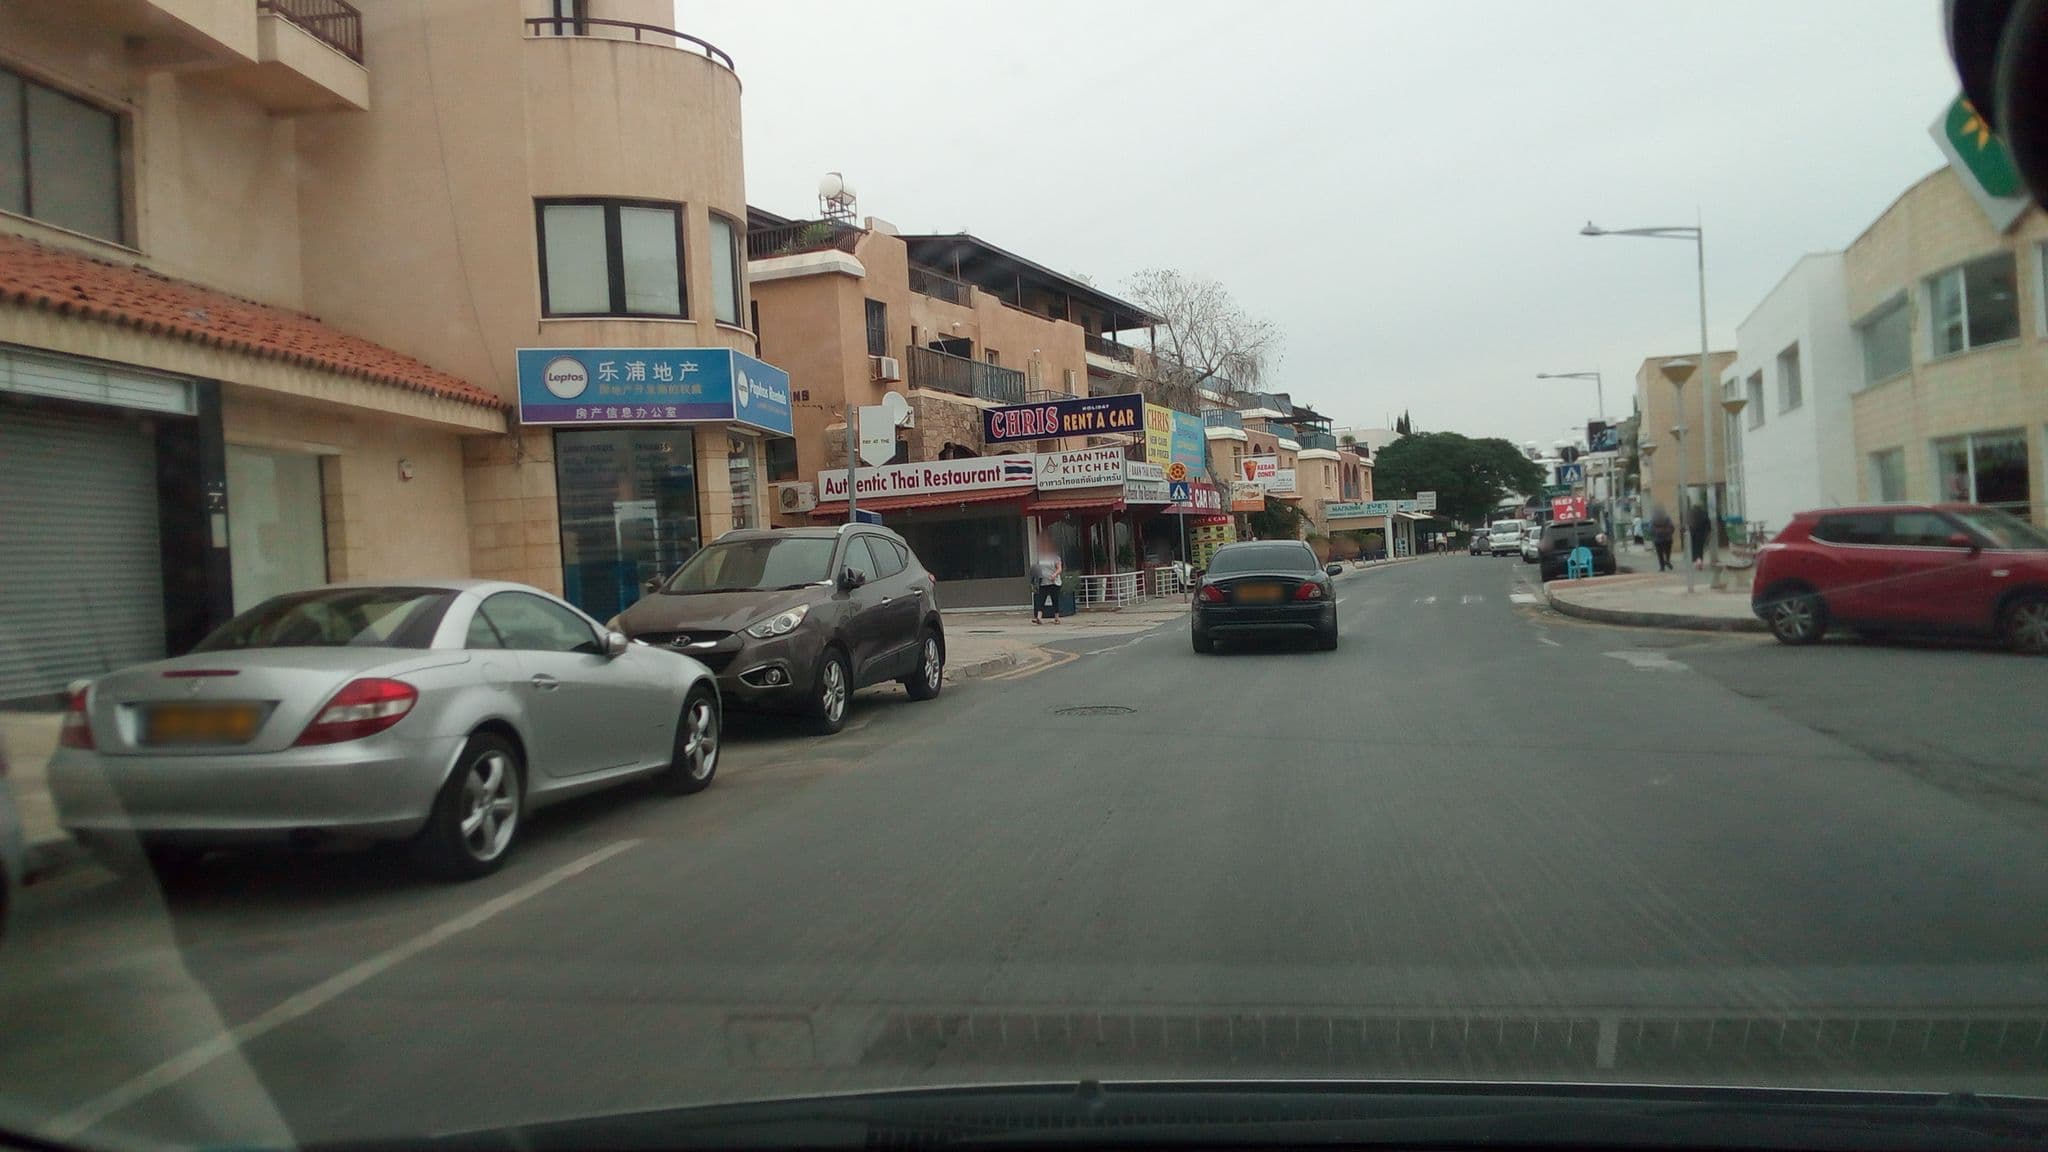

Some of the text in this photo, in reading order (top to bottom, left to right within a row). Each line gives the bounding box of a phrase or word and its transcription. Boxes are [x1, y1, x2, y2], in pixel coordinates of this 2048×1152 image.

[548, 372, 584, 385] Leptos
[598, 360, 700, 382] 乐浦地产
[575, 406, 678, 419] 房产信息办公室
[991, 406, 1060, 438] CHRIS
[1063, 409, 1135, 432] RENT A CAR
[1147, 409, 1170, 433] CHRIS
[1062, 451, 1119, 463] BAAN THAI
[1063, 461, 1120, 474] KITCHEN
[825, 465, 1001, 496] Autentic Thai Restaurant
[1195, 488, 1208, 508] CAR
